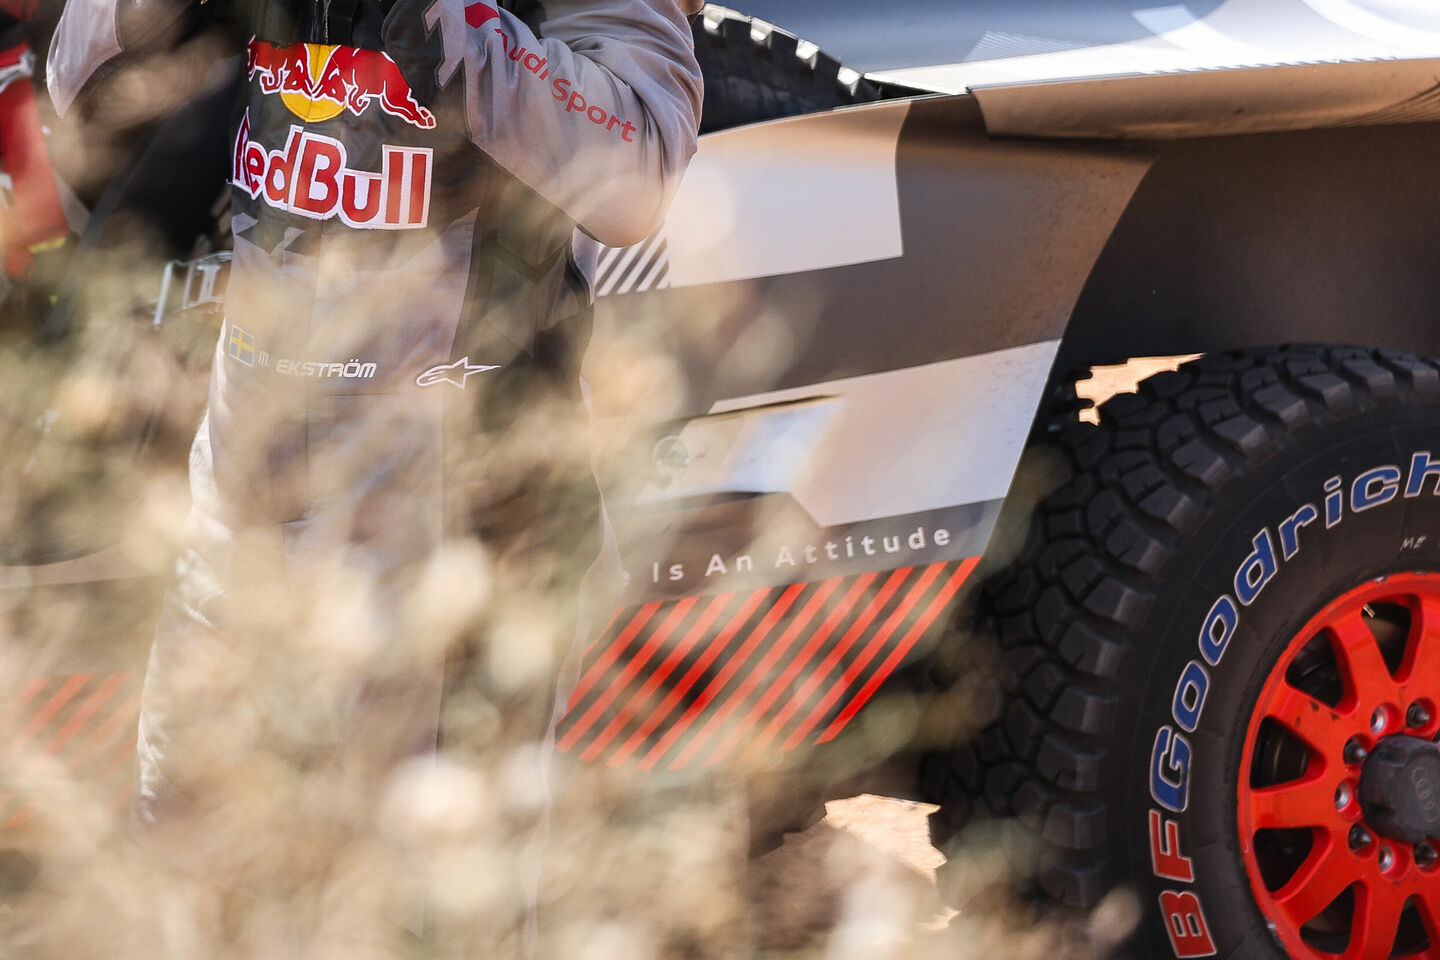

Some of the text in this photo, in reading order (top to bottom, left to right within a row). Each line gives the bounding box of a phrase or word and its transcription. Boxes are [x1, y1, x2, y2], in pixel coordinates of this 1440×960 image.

[551, 78, 637, 143] Sport
[275, 358, 377, 378] EKSTRÖM
[652, 561, 684, 583] Is
[704, 553, 753, 577] An
[774, 527, 952, 568] Attitude
